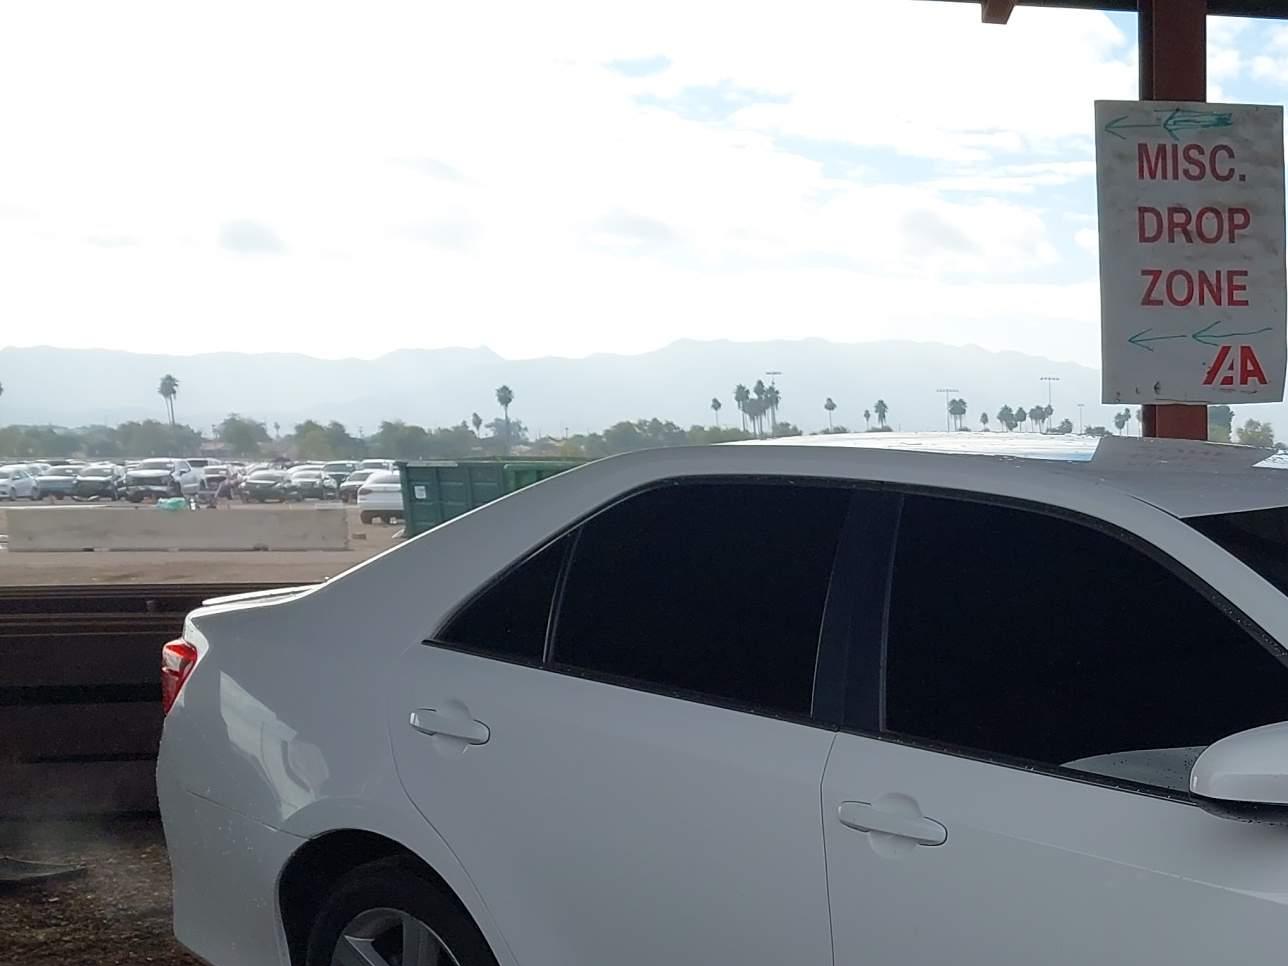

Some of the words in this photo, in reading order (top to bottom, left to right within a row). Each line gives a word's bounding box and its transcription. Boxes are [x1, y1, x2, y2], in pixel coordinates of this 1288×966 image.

[1137, 142, 1247, 182] MISC.
[1137, 206, 1251, 244] DROP
[1140, 269, 1249, 307] ZONE
